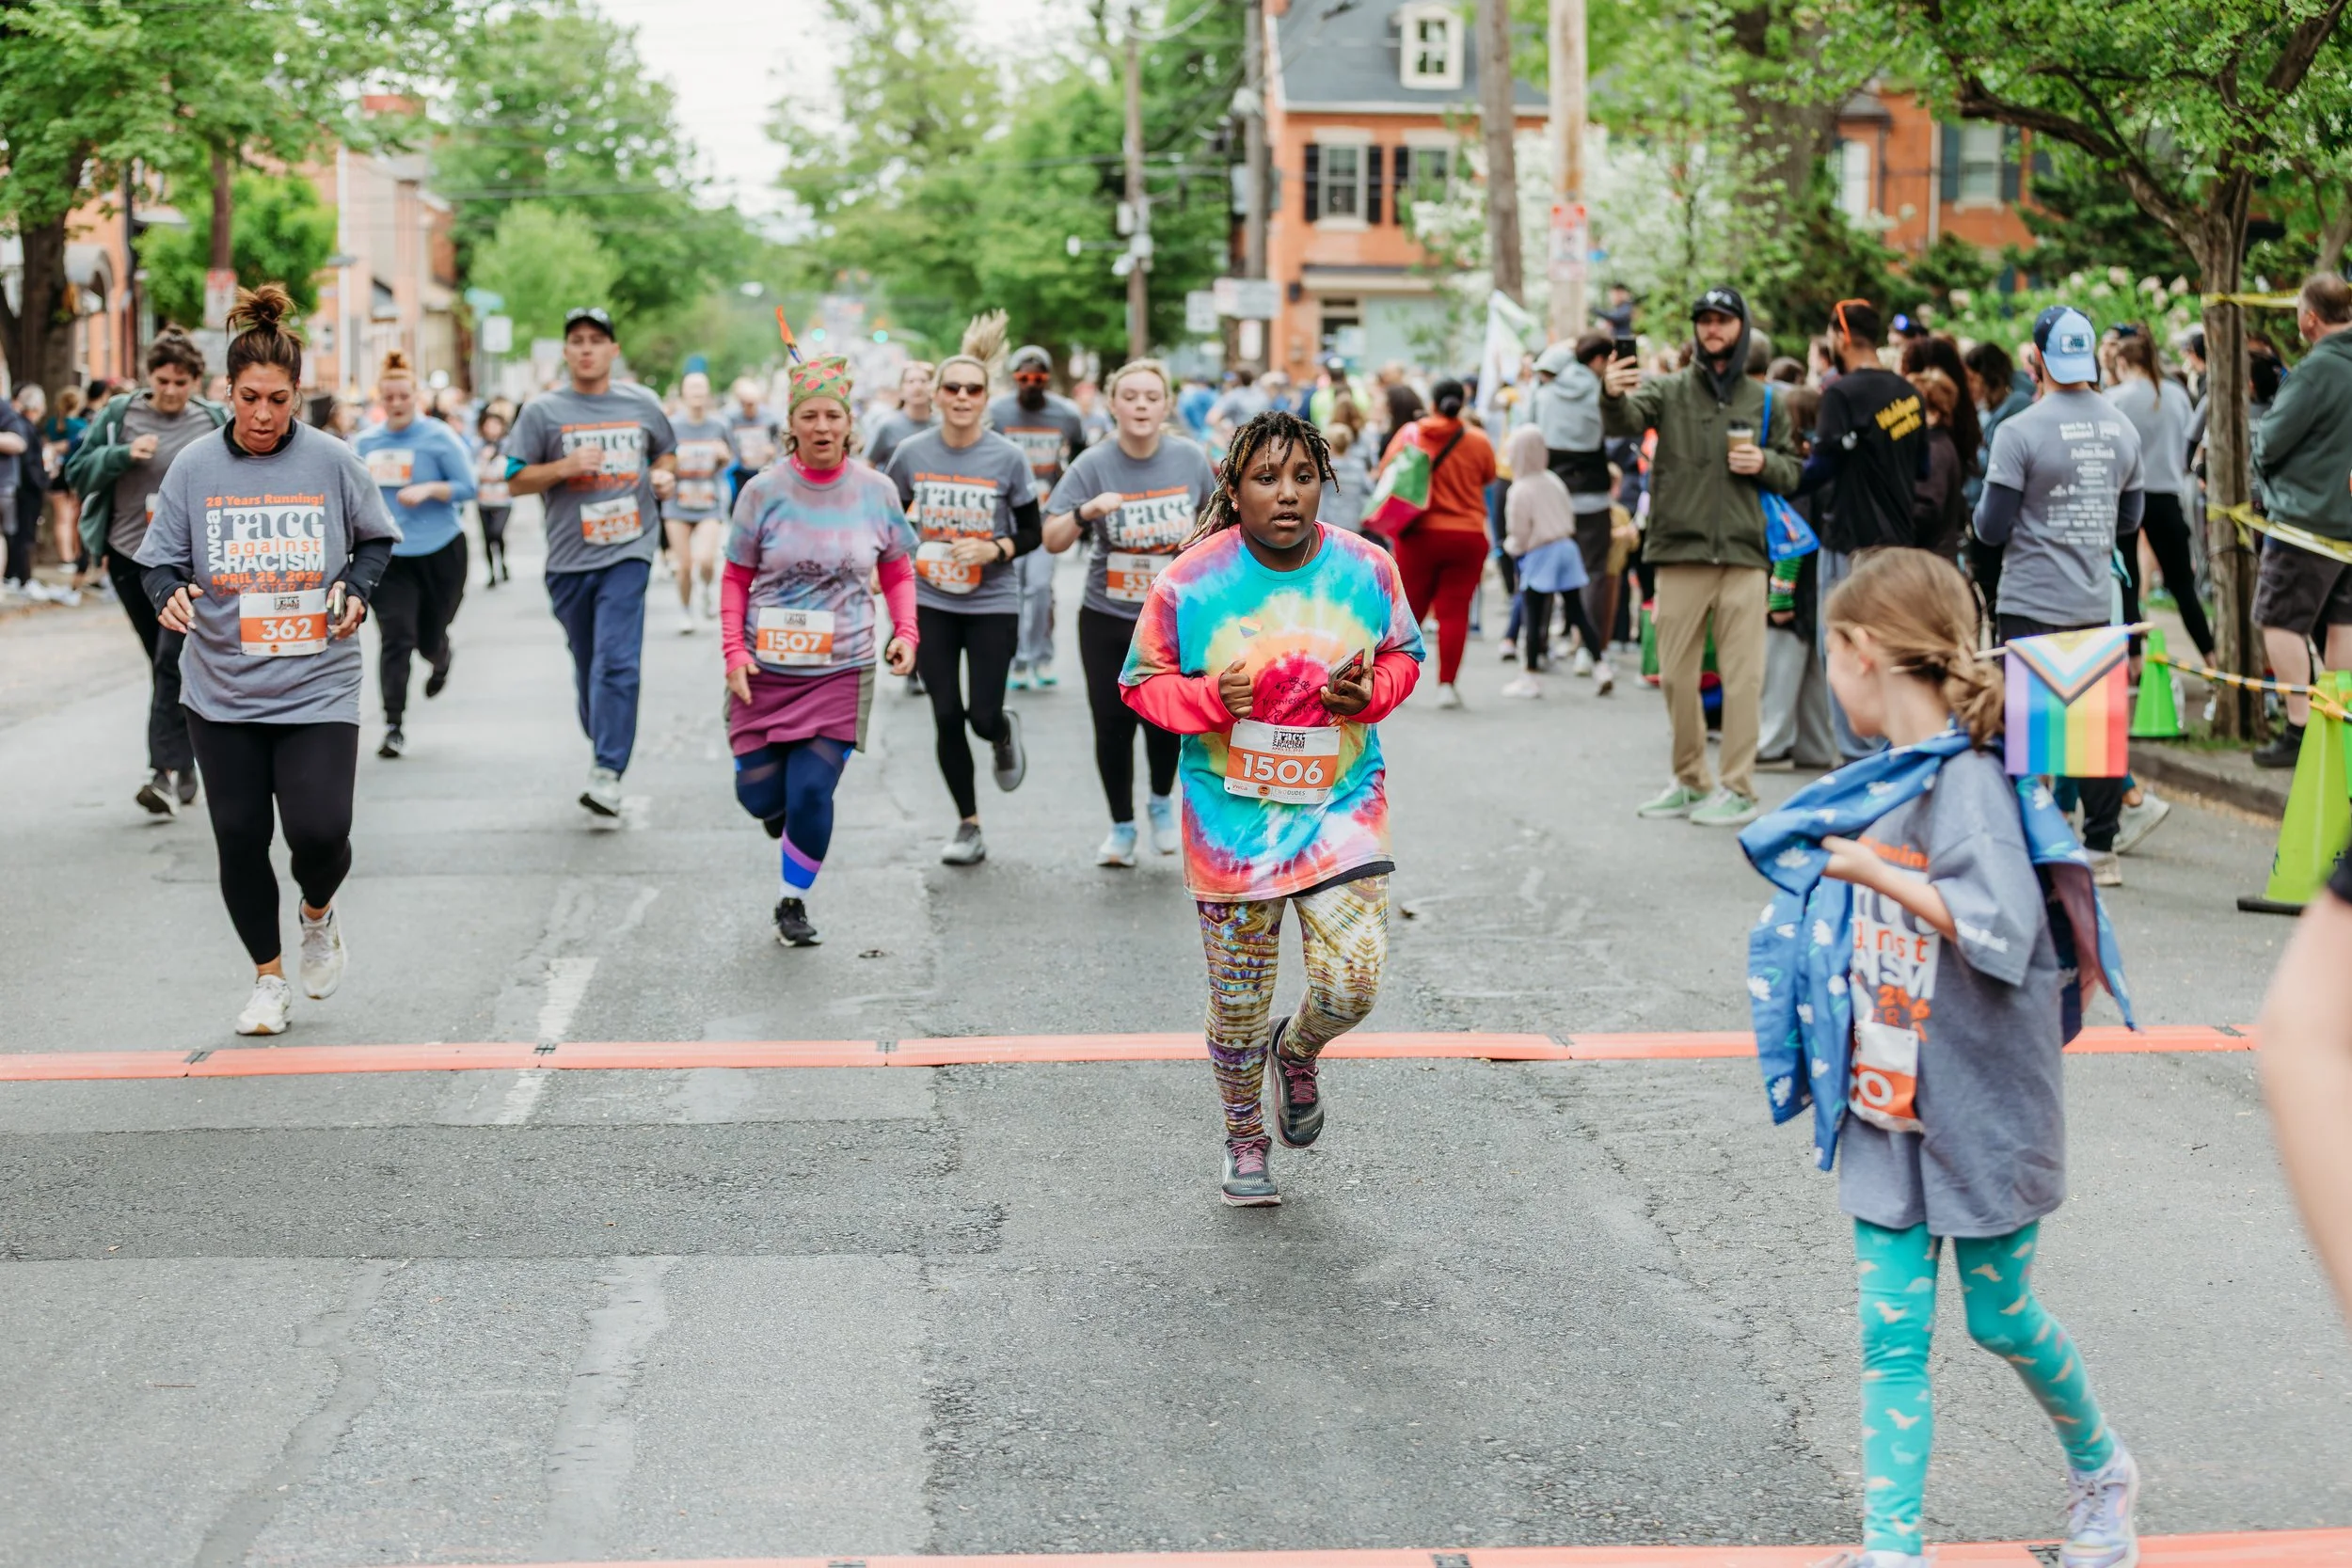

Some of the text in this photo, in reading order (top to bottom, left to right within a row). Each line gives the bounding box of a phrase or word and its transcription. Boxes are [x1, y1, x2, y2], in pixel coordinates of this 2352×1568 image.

[205, 493, 325, 507] 28 Years Running!
[922, 486, 994, 510] race
[1117, 500, 1190, 527] race
[223, 511, 325, 539] race
[206, 509, 225, 573] ywca
[229, 538, 321, 557] against
[224, 553, 325, 573] RACISM
[928, 562, 970, 582] 530
[212, 573, 253, 585] APRIL
[285, 571, 323, 584] 2026
[262, 617, 312, 640] 362
[767, 631, 823, 652] 1507
[1243, 752, 1324, 785] 1506
